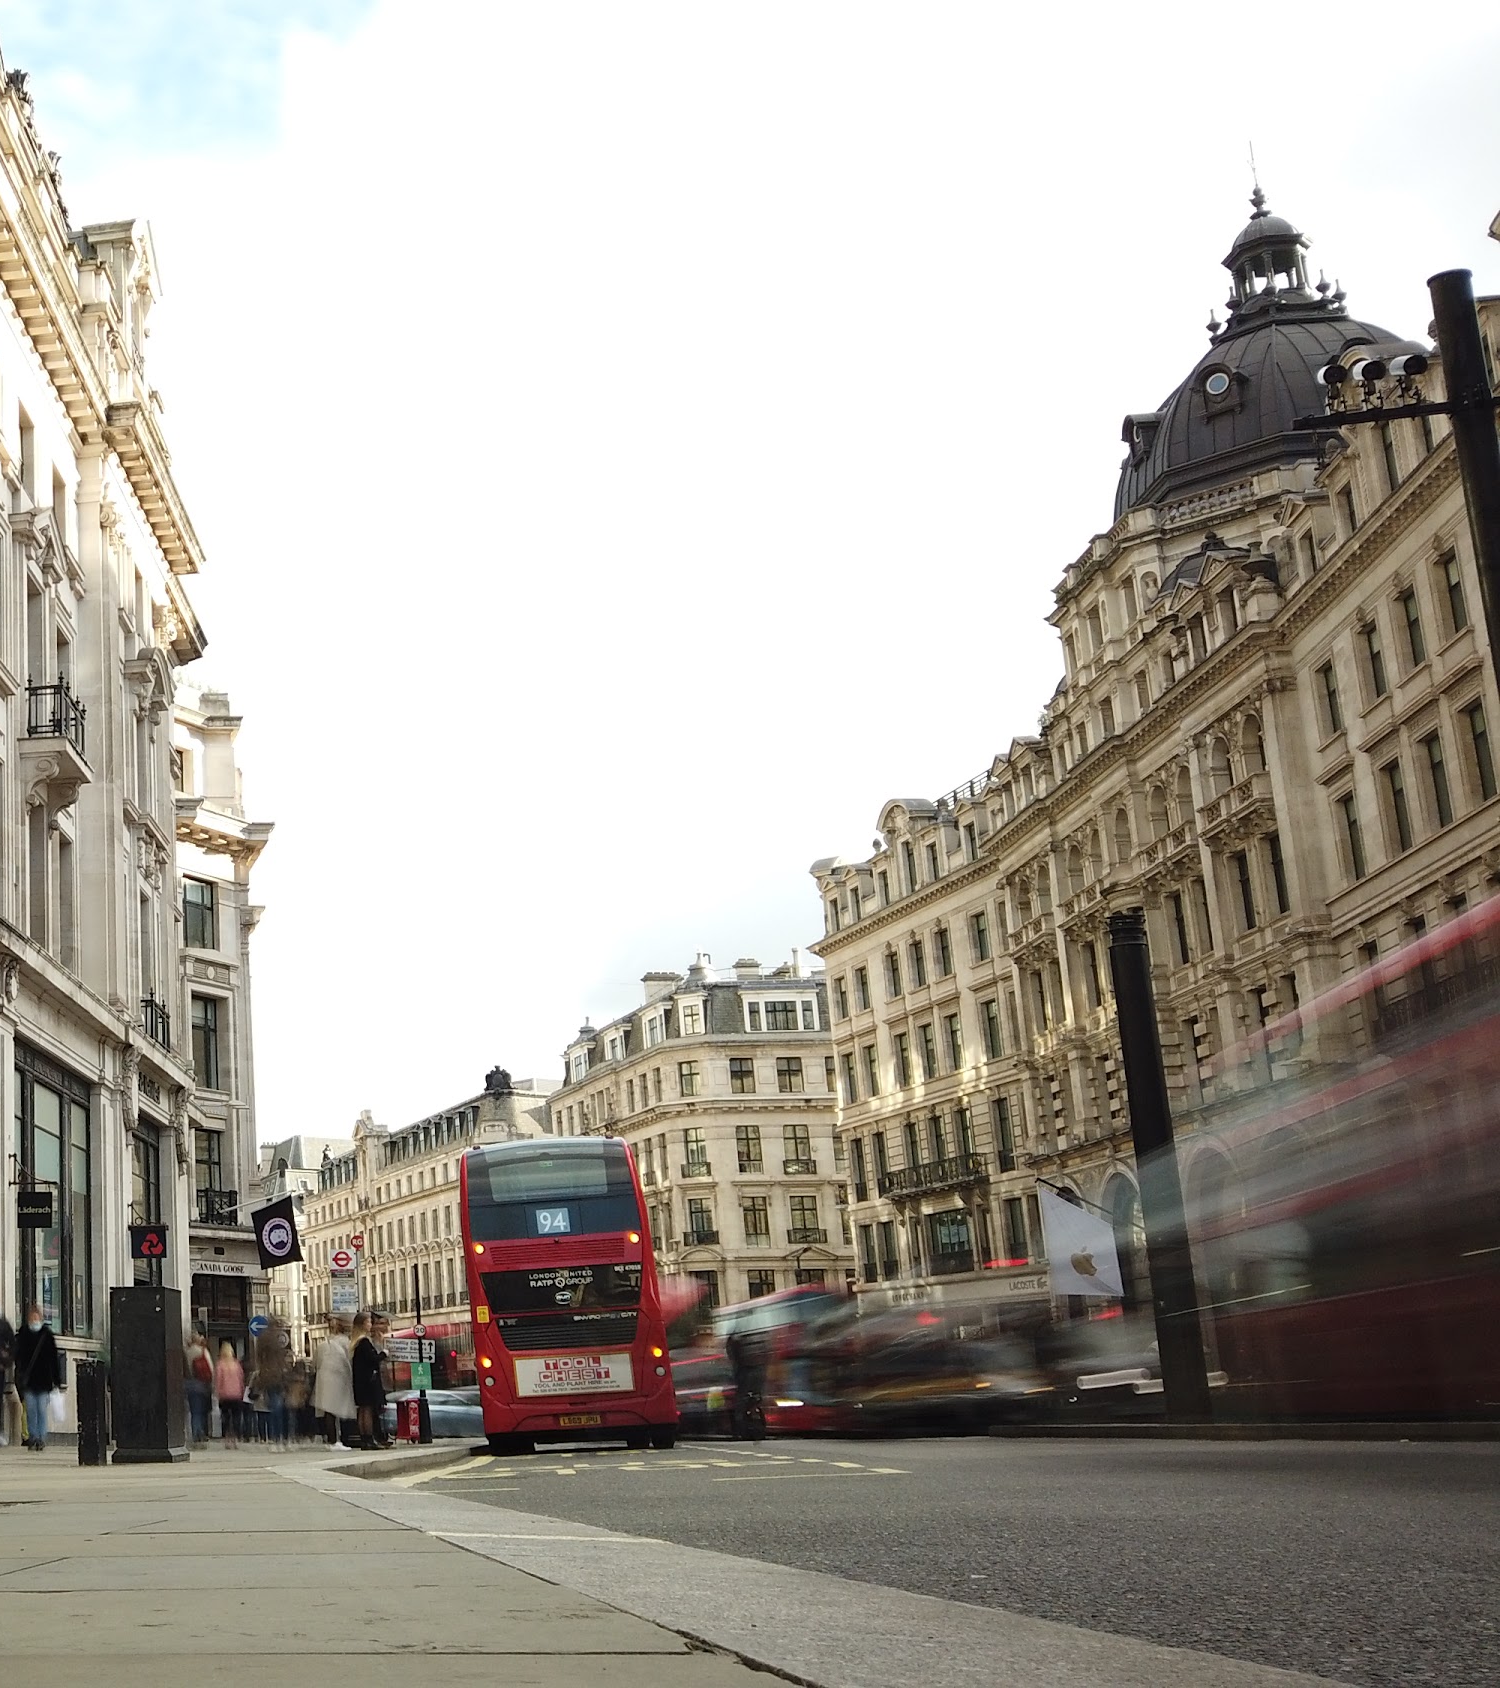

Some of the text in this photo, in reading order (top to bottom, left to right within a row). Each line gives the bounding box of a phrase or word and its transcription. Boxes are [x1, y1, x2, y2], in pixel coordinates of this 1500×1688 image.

[18, 1206, 51, 1214] Läderach
[539, 1211, 566, 1231] 94
[352, 1238, 363, 1246] RG
[223, 1265, 245, 1274] GOOSE
[567, 1277, 593, 1285] GROUP
[1009, 1279, 1035, 1291] LACOSTE
[544, 1356, 601, 1370] TOOL
[539, 1367, 610, 1382] CHEST
